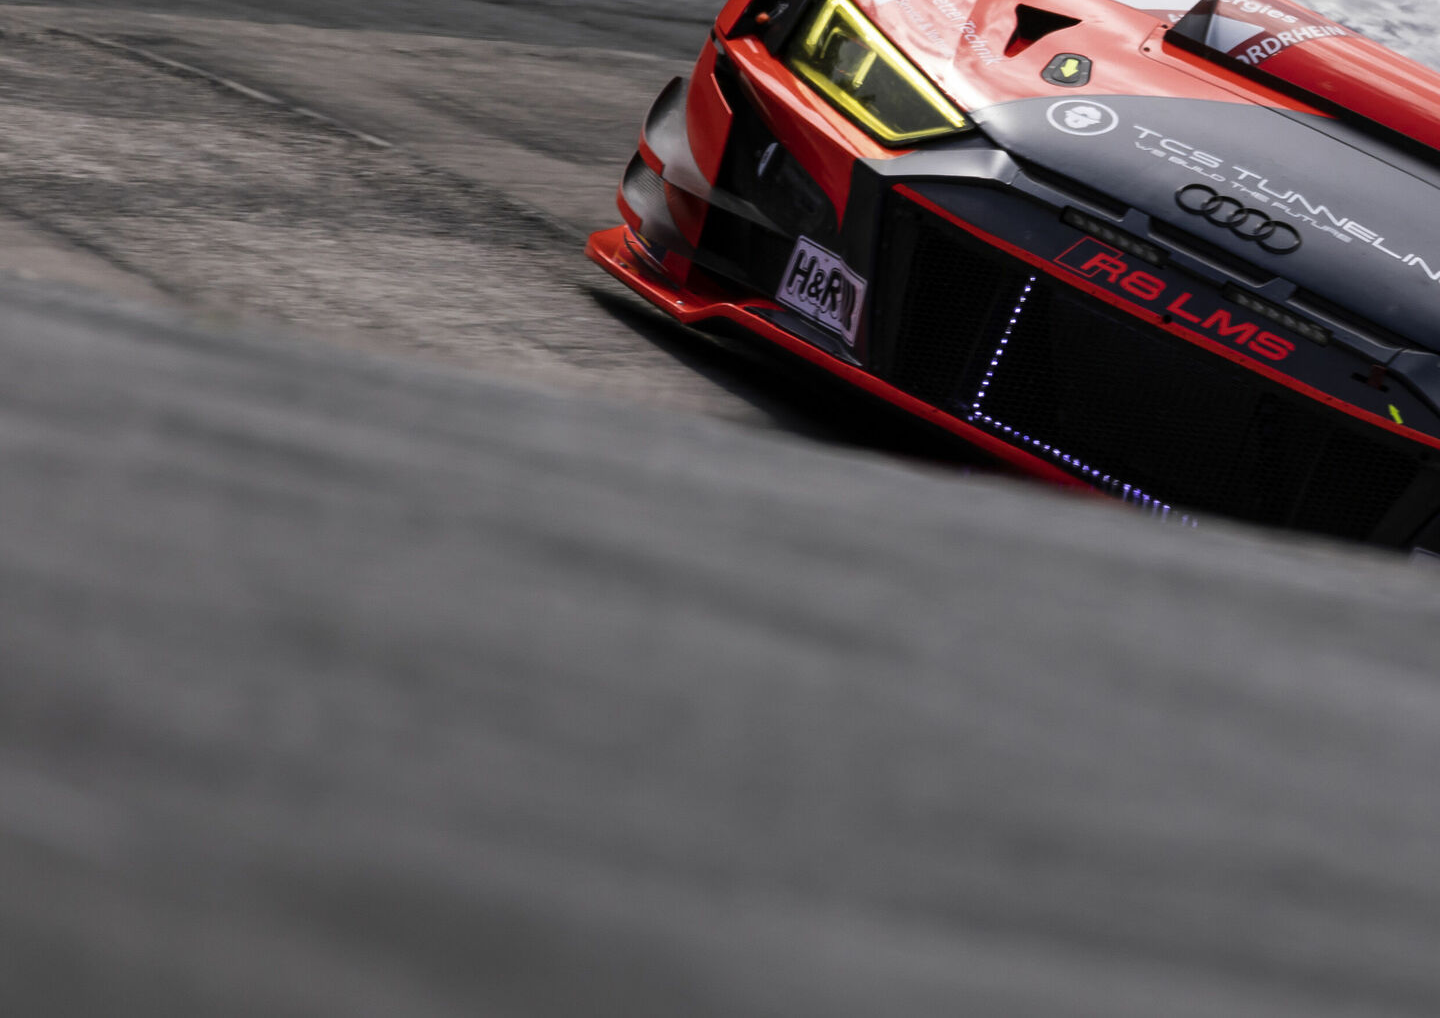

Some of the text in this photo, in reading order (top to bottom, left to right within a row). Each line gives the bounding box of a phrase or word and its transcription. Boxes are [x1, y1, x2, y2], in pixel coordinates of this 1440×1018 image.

[1133, 124, 1225, 169] TCS
[1168, 155, 1226, 183] BUILD
[1230, 181, 1270, 203] THE
[1271, 201, 1353, 243] FUTURE
[785, 248, 843, 318] H&R
[1080, 252, 1297, 362] R8 LMS
